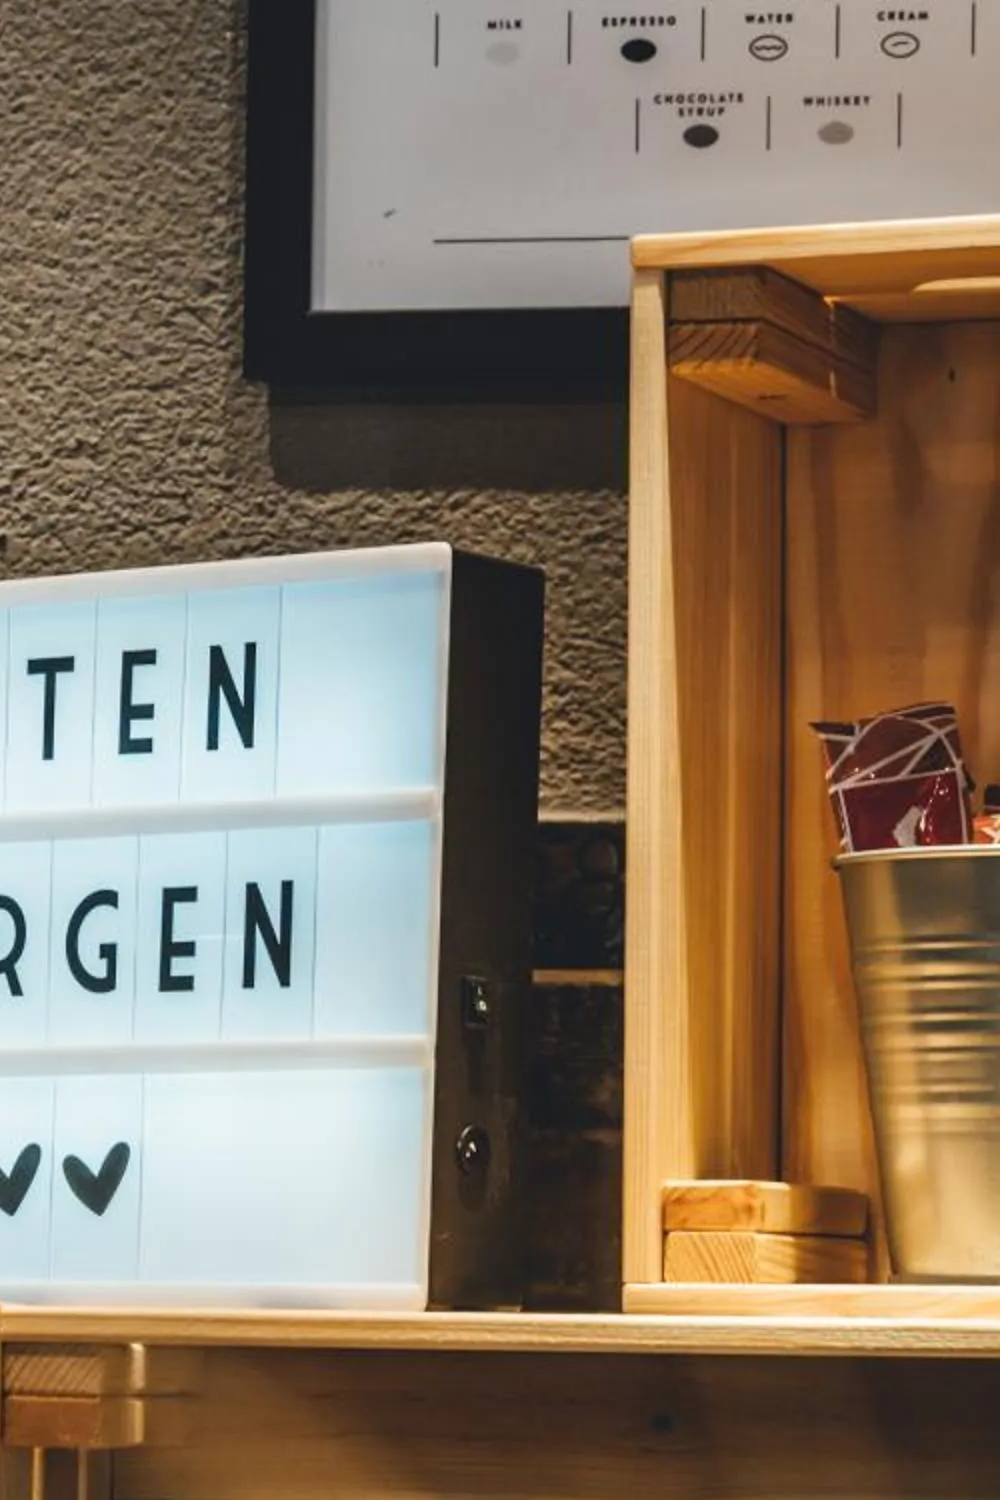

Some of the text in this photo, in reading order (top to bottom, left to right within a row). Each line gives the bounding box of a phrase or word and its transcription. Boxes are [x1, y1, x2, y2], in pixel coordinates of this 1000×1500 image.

[601, 15, 677, 28] ESPRESSO
[745, 13, 794, 24] WATER
[877, 11, 930, 22] CREAM
[487, 19, 523, 30] MILK
[652, 92, 744, 105] CHOCOLATE
[802, 95, 872, 106] WHISKEY
[677, 106, 726, 117] SYRUP
